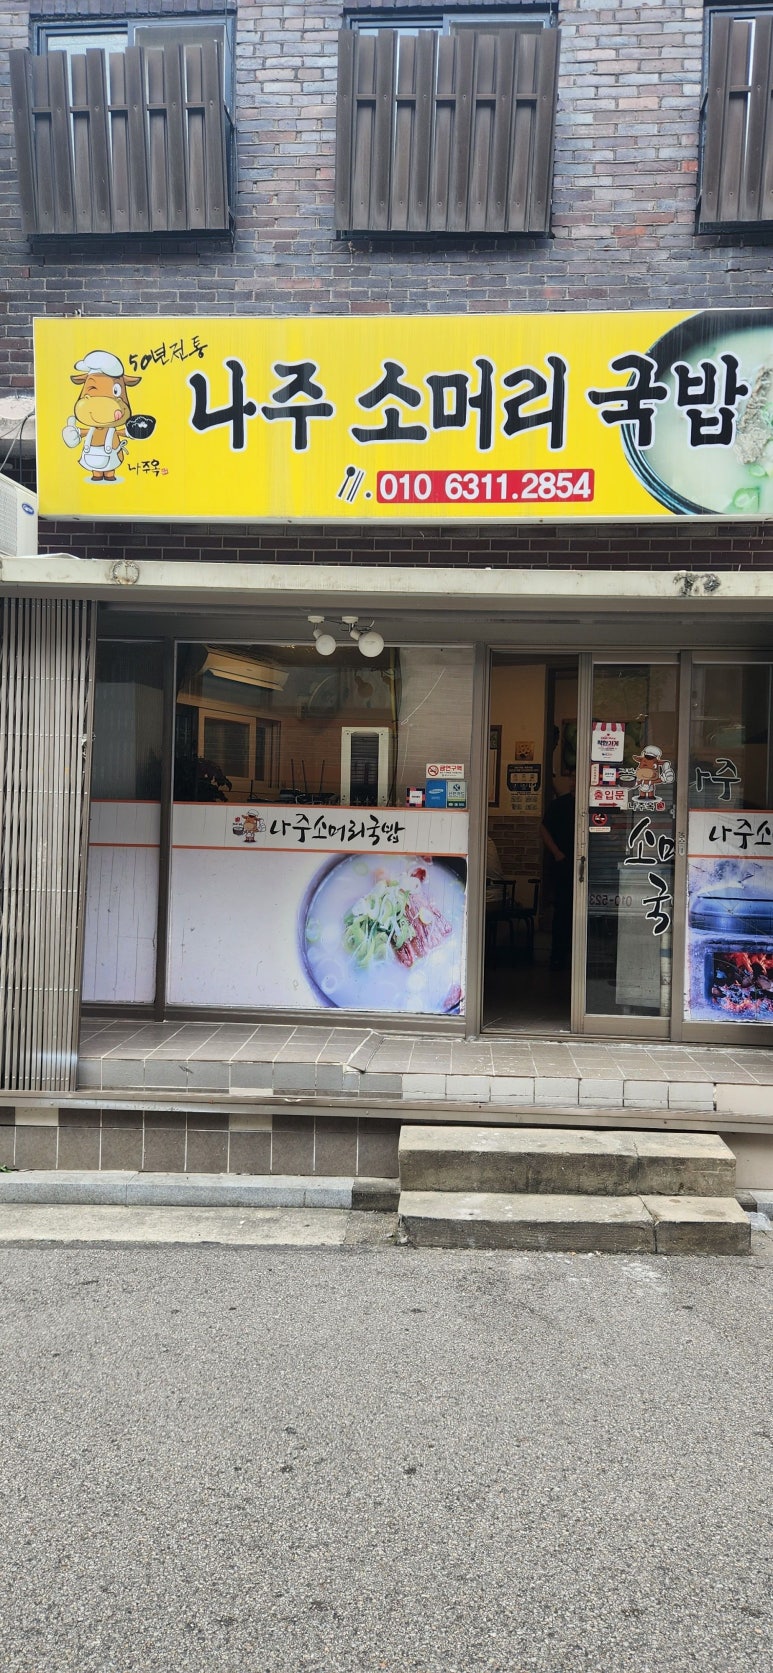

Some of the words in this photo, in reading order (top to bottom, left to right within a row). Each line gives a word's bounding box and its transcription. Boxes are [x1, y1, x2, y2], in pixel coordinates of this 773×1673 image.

[188, 359, 335, 451] 나주
[350, 356, 568, 452] 소머리
[587, 353, 750, 449] 국밥
[127, 459, 160, 477] 나주옥
[379, 473, 432, 500] 010
[445, 471, 591, 499] 6311.2854
[594, 790, 624, 801] 출입문
[628, 802, 655, 811] 나주옥
[270, 814, 405, 845] 나주소머리국밥
[708, 818, 773, 850] 나주소
